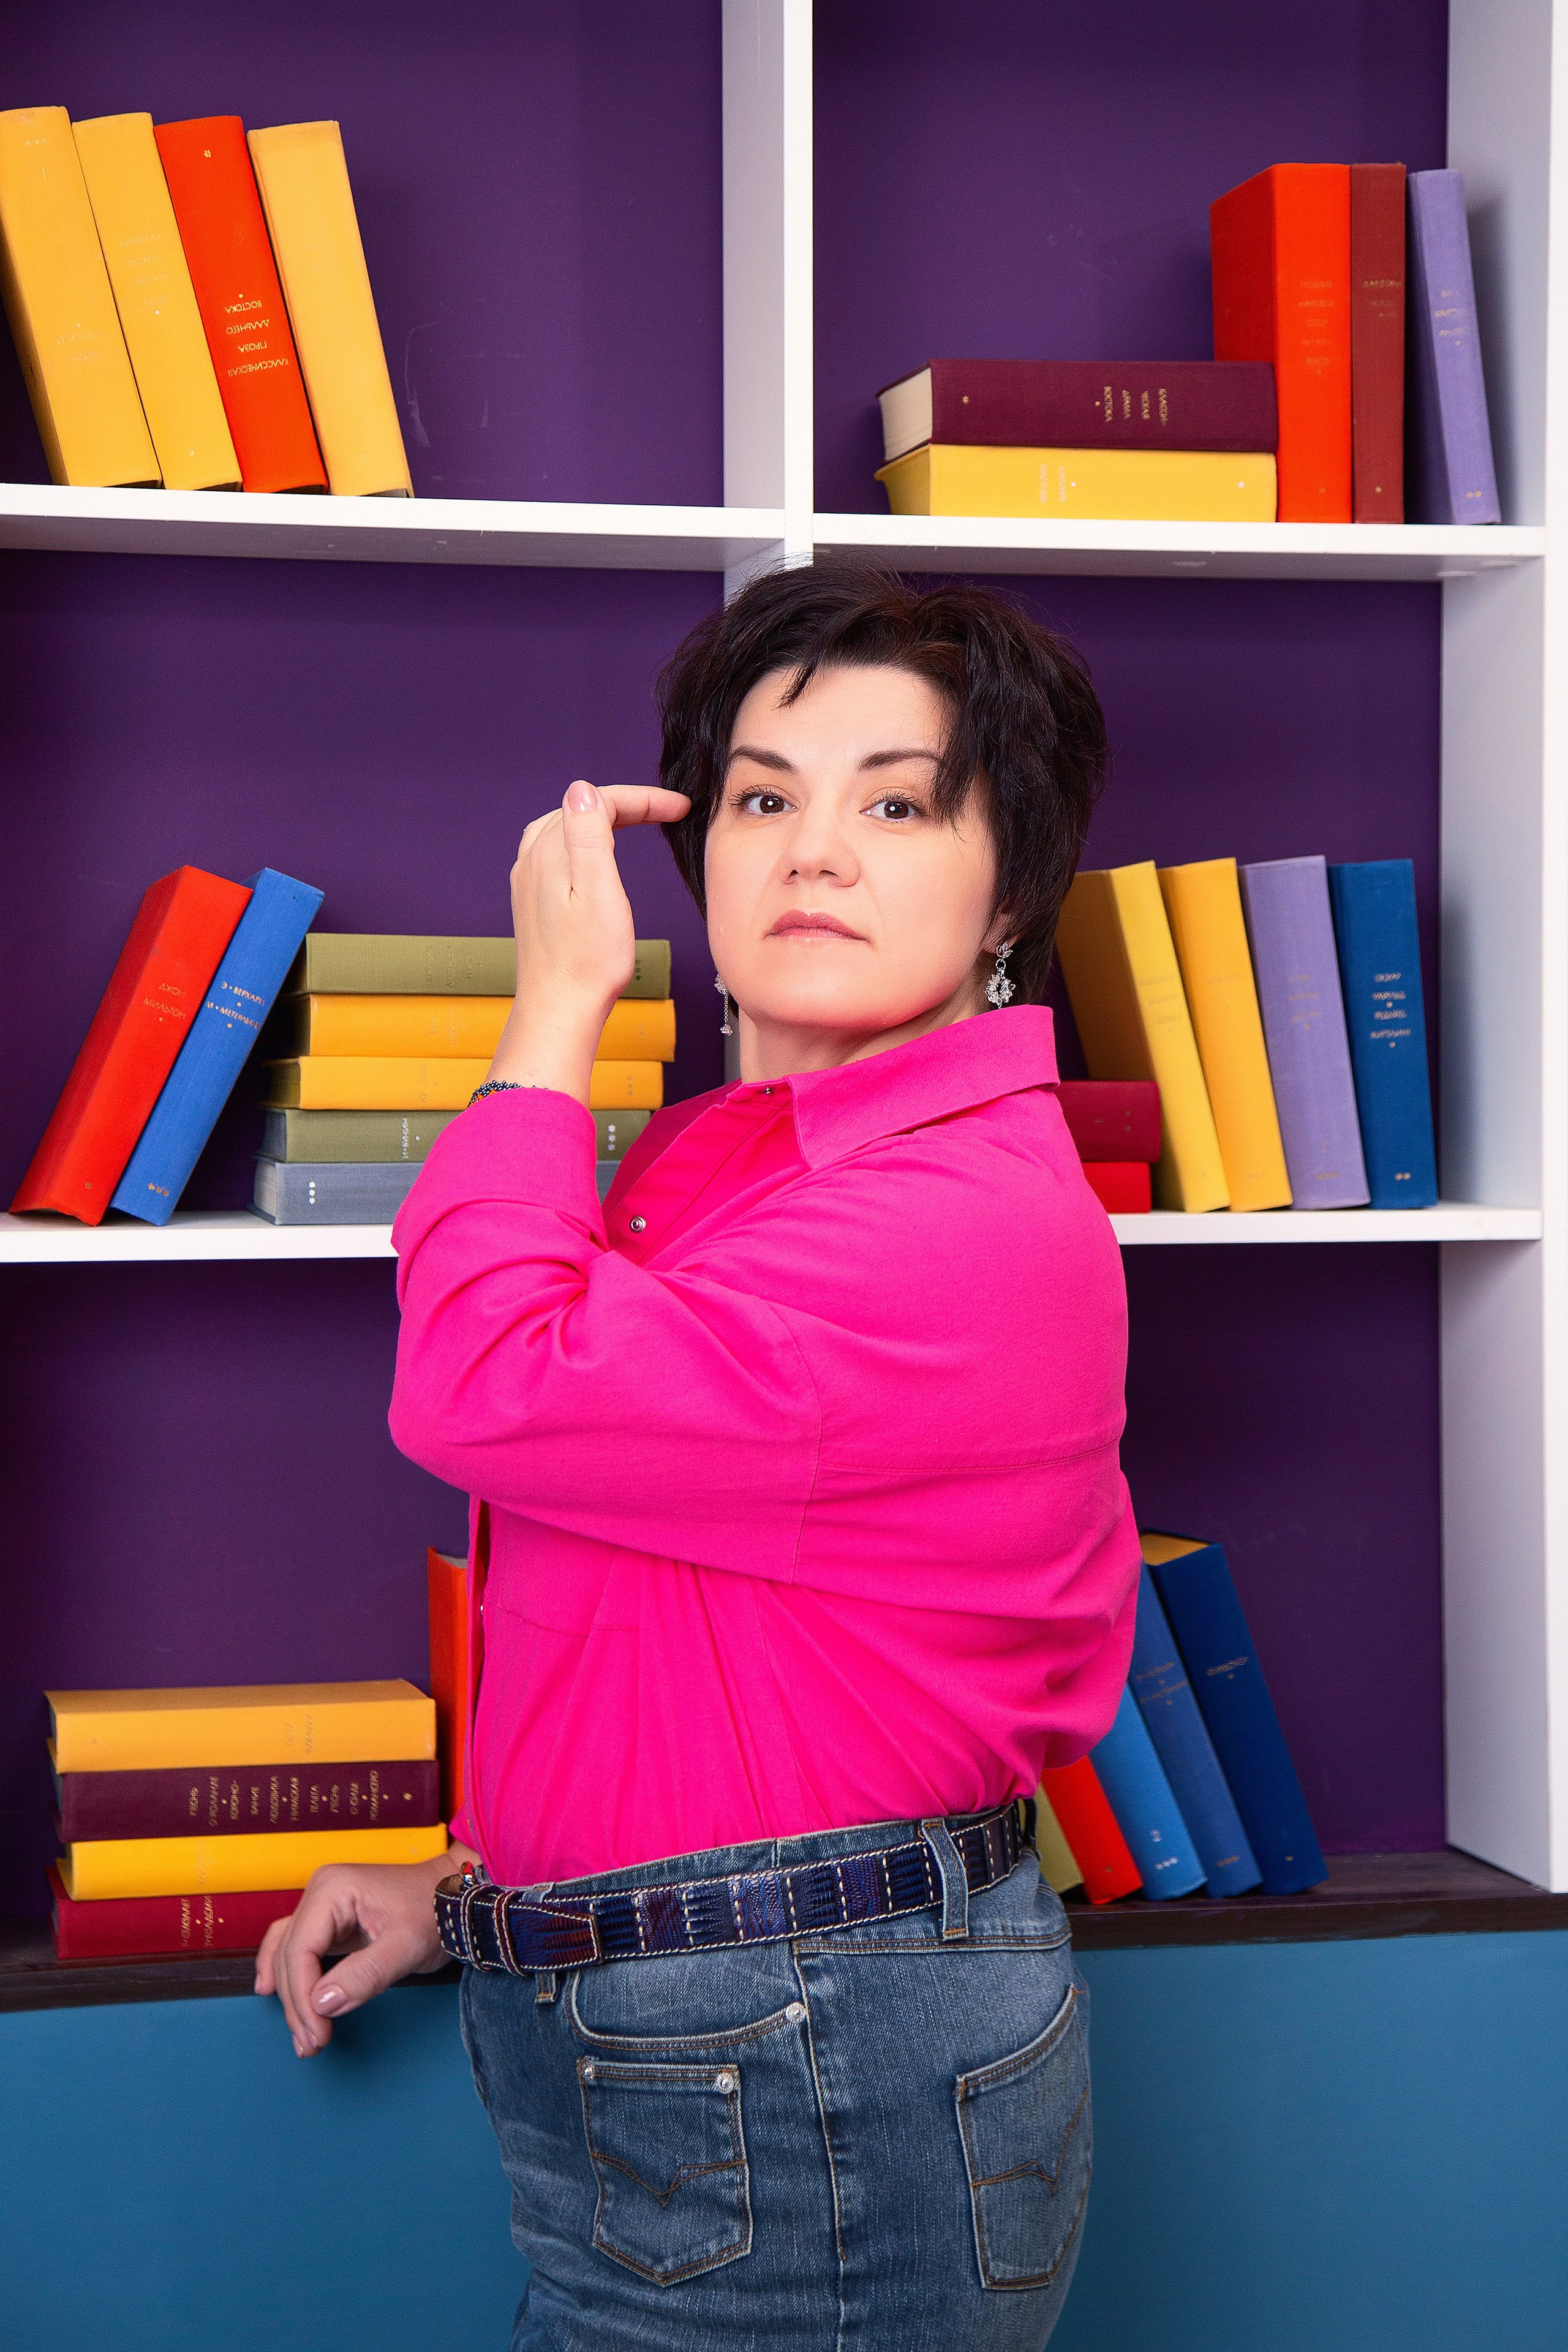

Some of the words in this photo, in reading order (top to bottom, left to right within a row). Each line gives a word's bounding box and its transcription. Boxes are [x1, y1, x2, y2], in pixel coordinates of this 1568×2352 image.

[224, 300, 262, 314] ВОСТОКА
[226, 318, 270, 334] ДАЛЬНЕГО
[238, 341, 268, 353] ПРОЗА
[228, 358, 289, 376] КЛАССИЧЕСКАЯ
[1104, 386, 1113, 423] ВОСТОКА
[1122, 390, 1131, 420] ДРАМА
[158, 982, 186, 997] ДЖОН
[143, 997, 187, 1020] МИЛЬТОН
[190, 1787, 199, 1815] ПЕСНЬ
[208, 1776, 219, 1817] РОЛАНДЕ
[251, 1786, 260, 1815] ВАНИЕ
[290, 1777, 299, 1820] НИМСКАЯ
[330, 1785, 339, 1813] ПЕСНЬ
